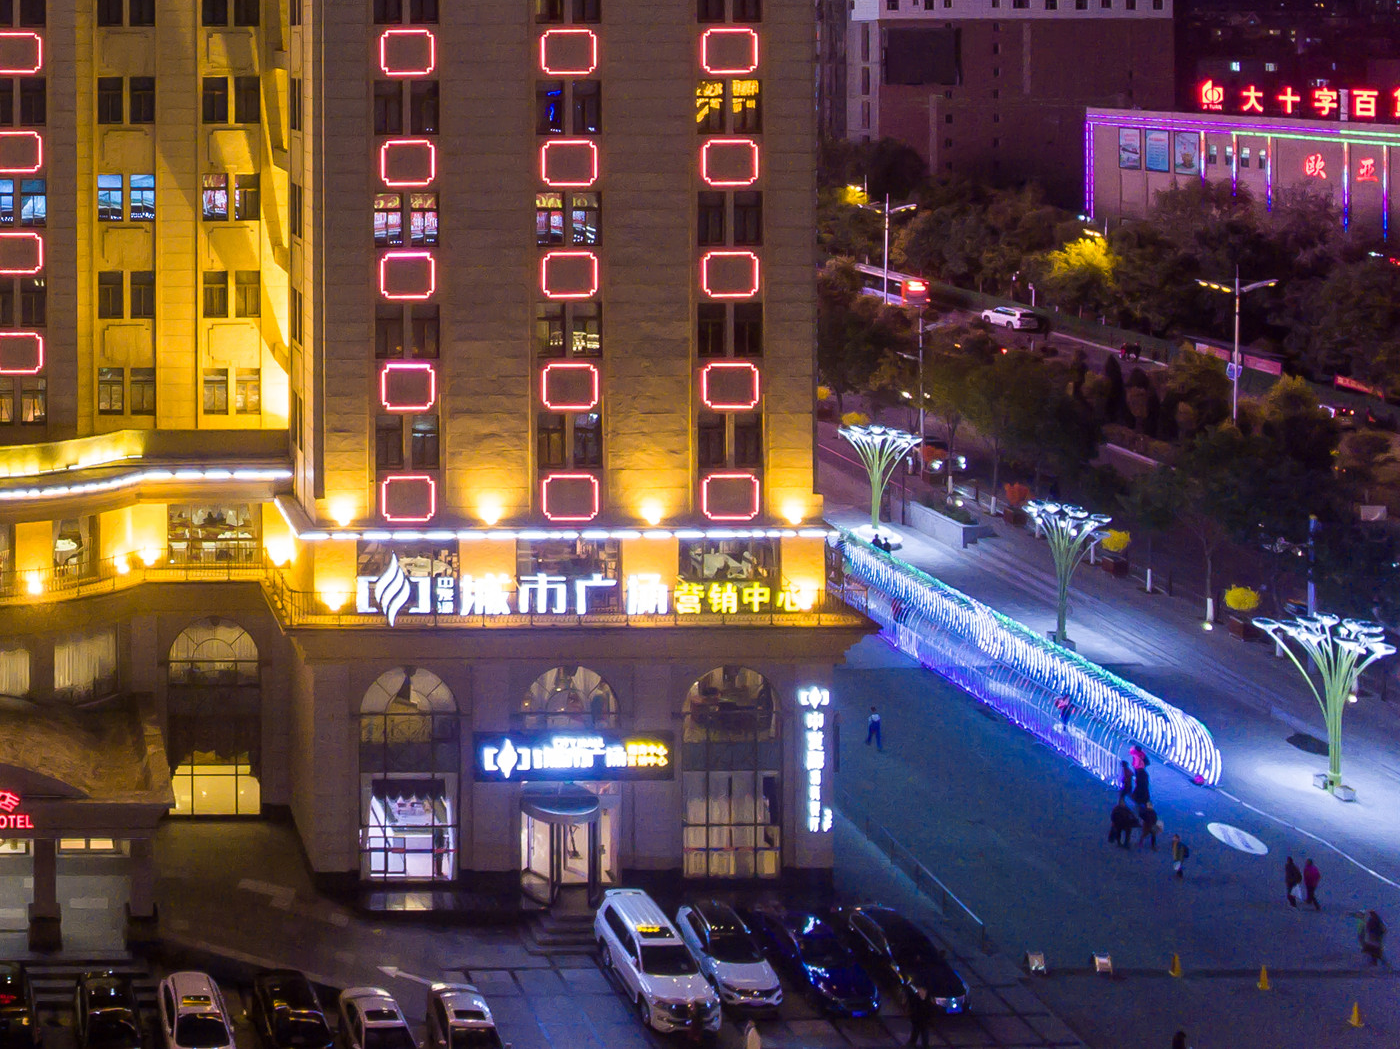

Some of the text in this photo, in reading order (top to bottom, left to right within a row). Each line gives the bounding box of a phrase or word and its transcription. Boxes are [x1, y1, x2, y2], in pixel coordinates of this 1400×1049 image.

[1305, 153, 1378, 182] 欧亚
[460, 573, 811, 616] 城市广场 营销中心
